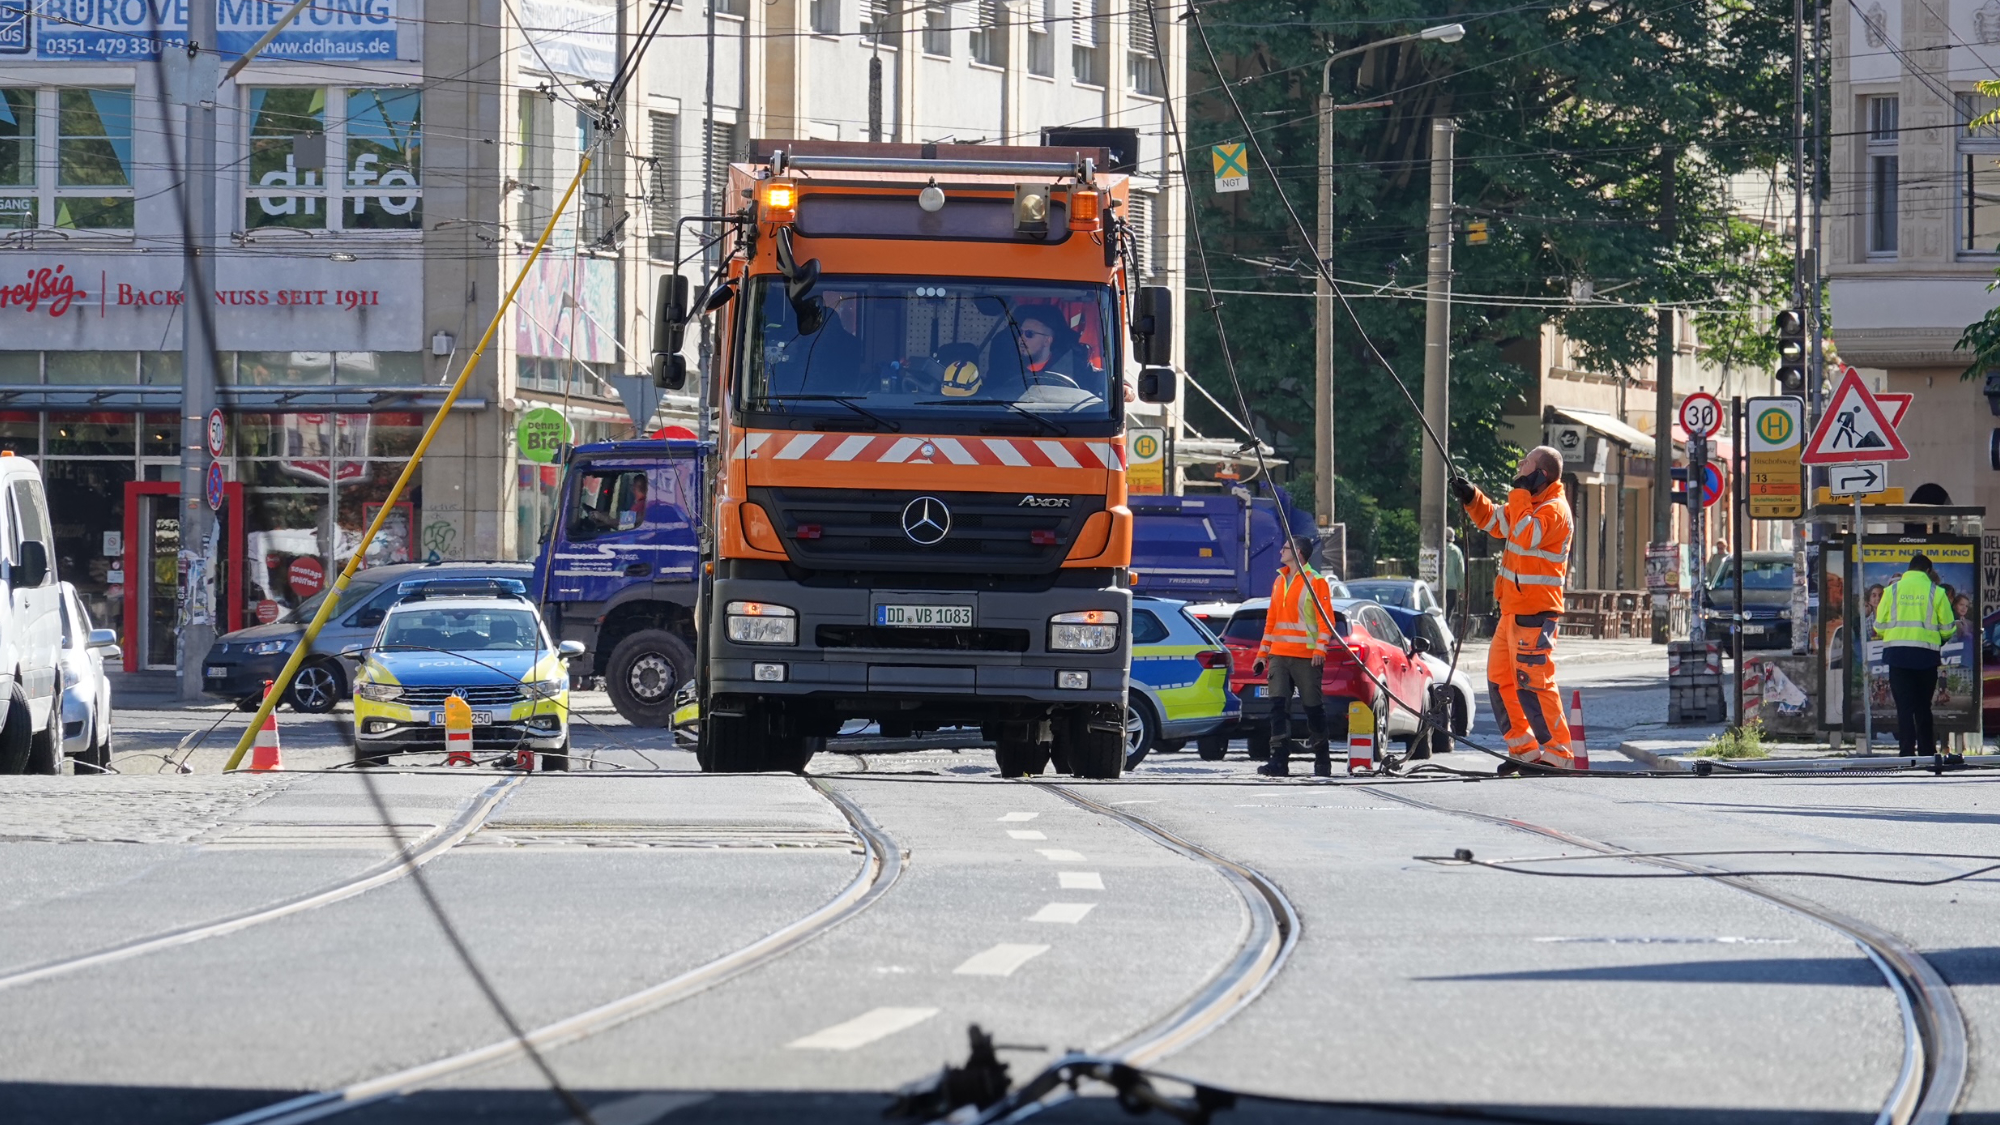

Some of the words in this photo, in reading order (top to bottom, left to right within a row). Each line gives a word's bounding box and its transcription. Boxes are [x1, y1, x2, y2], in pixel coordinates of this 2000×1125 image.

[255, 38, 390, 54] www.ddhaus.de
[1223, 178, 1240, 187] NGT
[335, 290, 379, 311] 1911
[1688, 406, 1713, 426] 30
[1767, 416, 1783, 436] H
[1754, 458, 1796, 466] Bischofsweg
[1756, 474, 1768, 483] 13
[1760, 485, 1767, 493] 6
[1857, 549, 1895, 557] ETZT
[1926, 549, 1939, 557] IM
[1942, 549, 1970, 557] KINO
[290, 566, 322, 579] sonntags
[290, 575, 318, 588] geöffnet
[887, 607, 905, 623] DD
[915, 608, 932, 624] VB
[936, 609, 970, 624] 1083
[418, 660, 502, 668] POLIZEI
